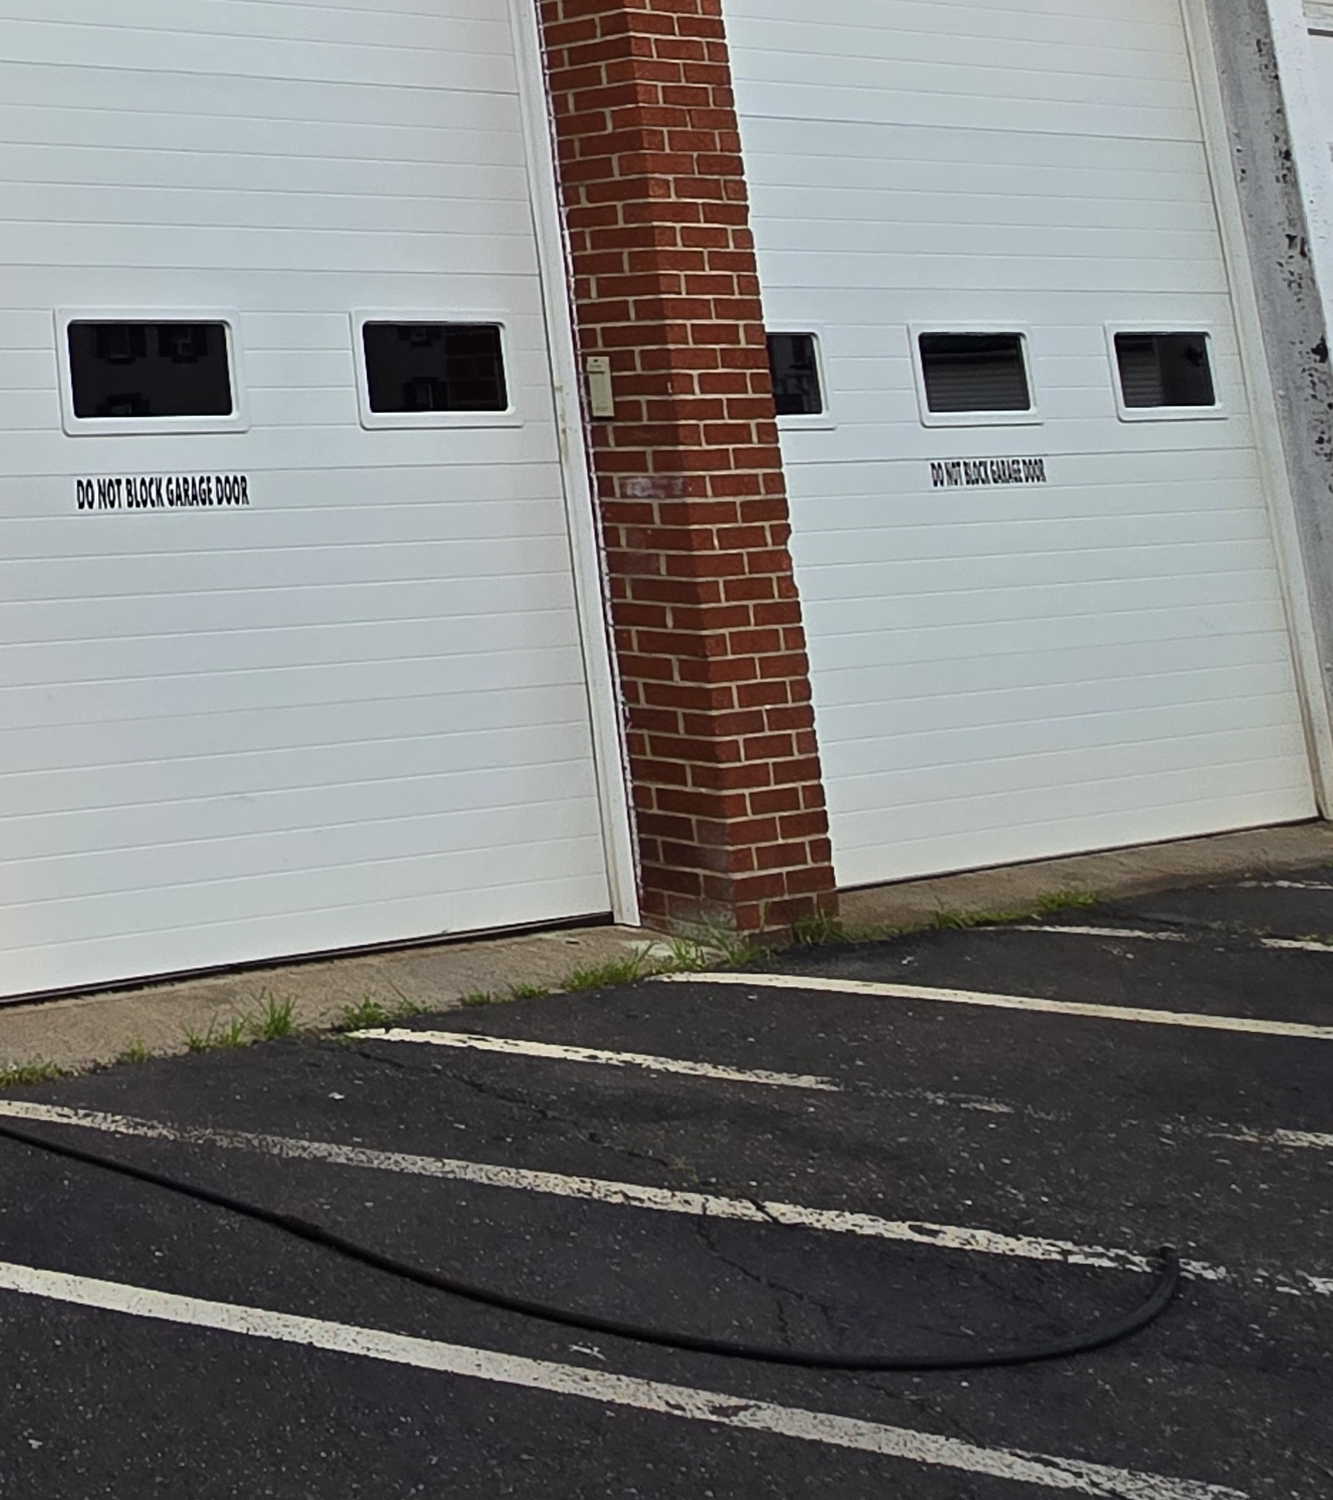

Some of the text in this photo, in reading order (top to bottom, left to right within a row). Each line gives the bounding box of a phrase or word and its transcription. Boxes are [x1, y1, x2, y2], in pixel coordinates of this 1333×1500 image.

[76, 475, 250, 509] DO NOT BLOCK GARAGE DOOR
